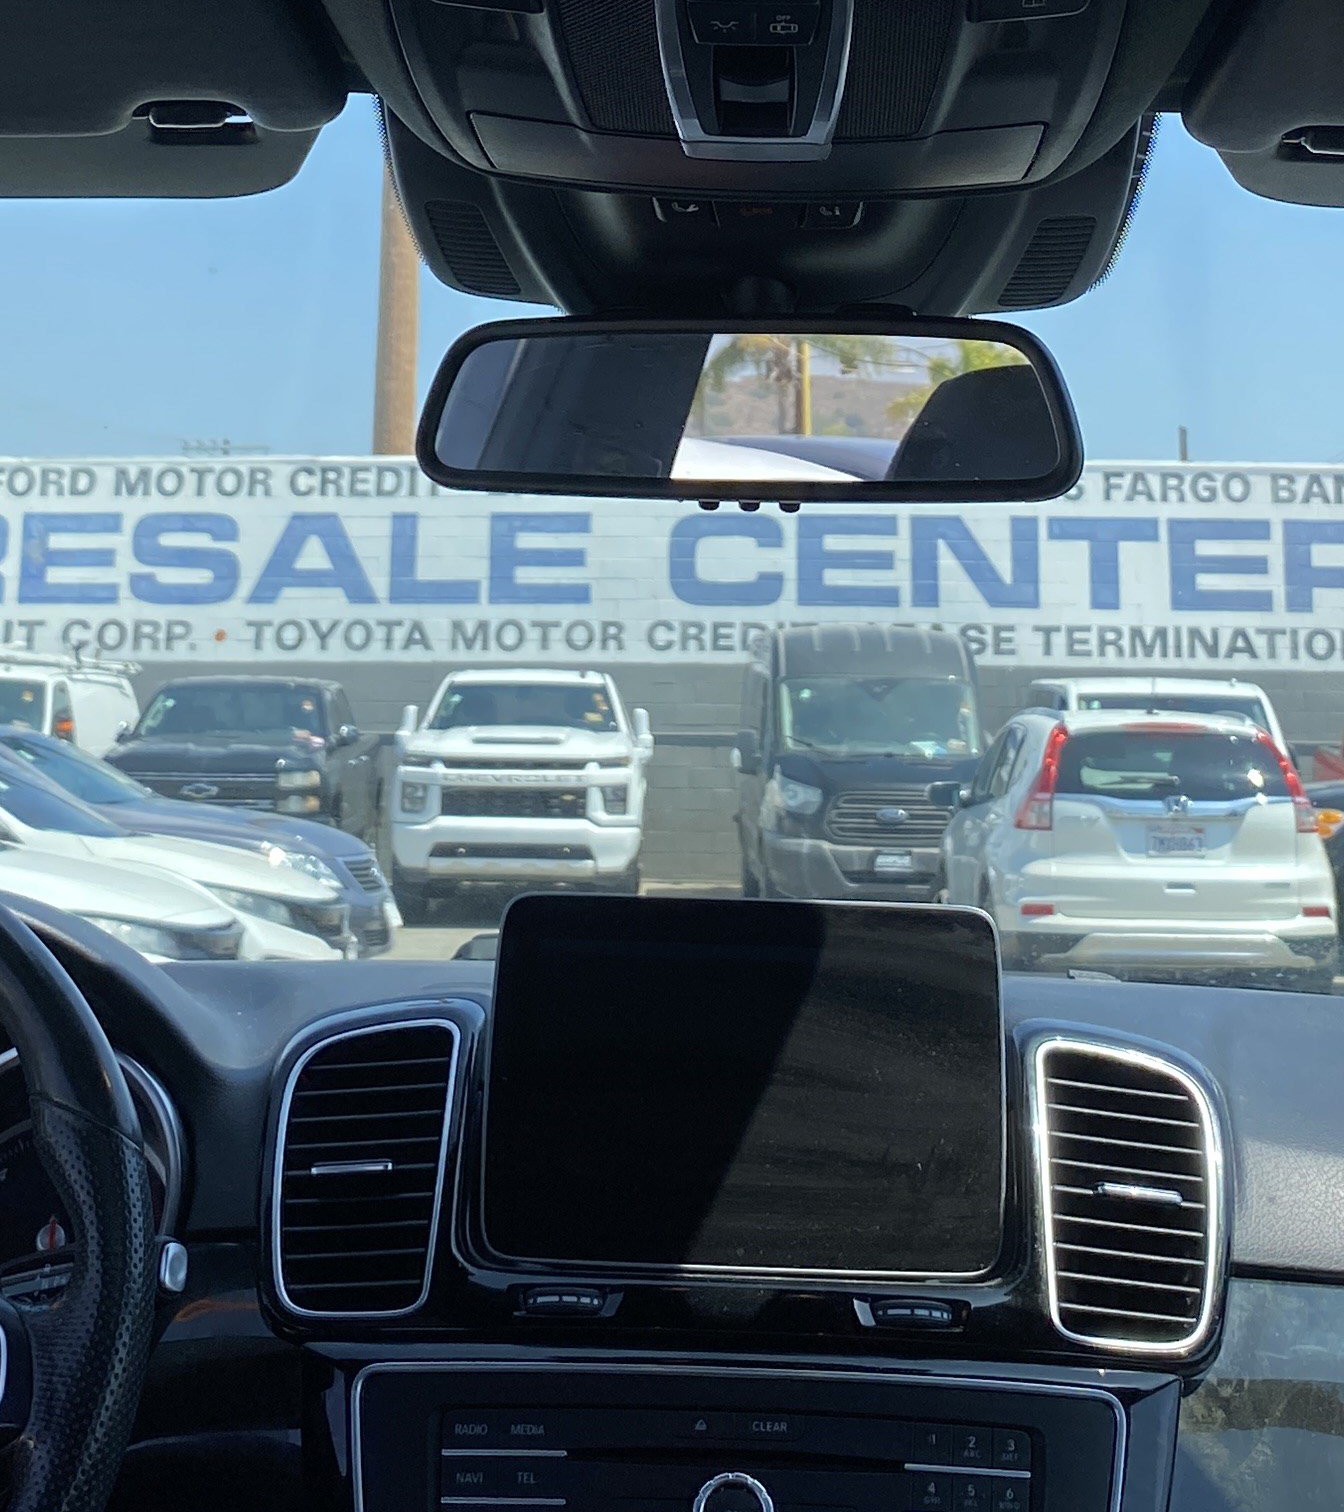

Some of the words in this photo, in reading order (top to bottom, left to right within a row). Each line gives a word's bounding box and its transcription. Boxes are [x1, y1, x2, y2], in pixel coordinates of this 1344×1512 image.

[115, 467, 273, 499] MOTOR
[289, 466, 439, 497] CREDI
[1102, 471, 1251, 504] FARGO
[62, 617, 197, 653] CORP.
[244, 619, 435, 654] TOYOTA
[449, 619, 626, 654] MOTOR
[645, 619, 818, 653] CRED
[454, 1423, 488, 1436] RADIO
[510, 1423, 545, 1437] MEDIA
[751, 1420, 789, 1434] CLEAR
[930, 1433, 936, 1444] 1
[967, 1436, 976, 1448] 2
[1007, 1439, 1015, 1451] 3
[456, 1471, 484, 1484] NAVI
[517, 1471, 536, 1484] TEL
[927, 1481, 937, 1494] 4
[967, 1483, 977, 1497] 5
[1006, 1487, 1015, 1500] 6
